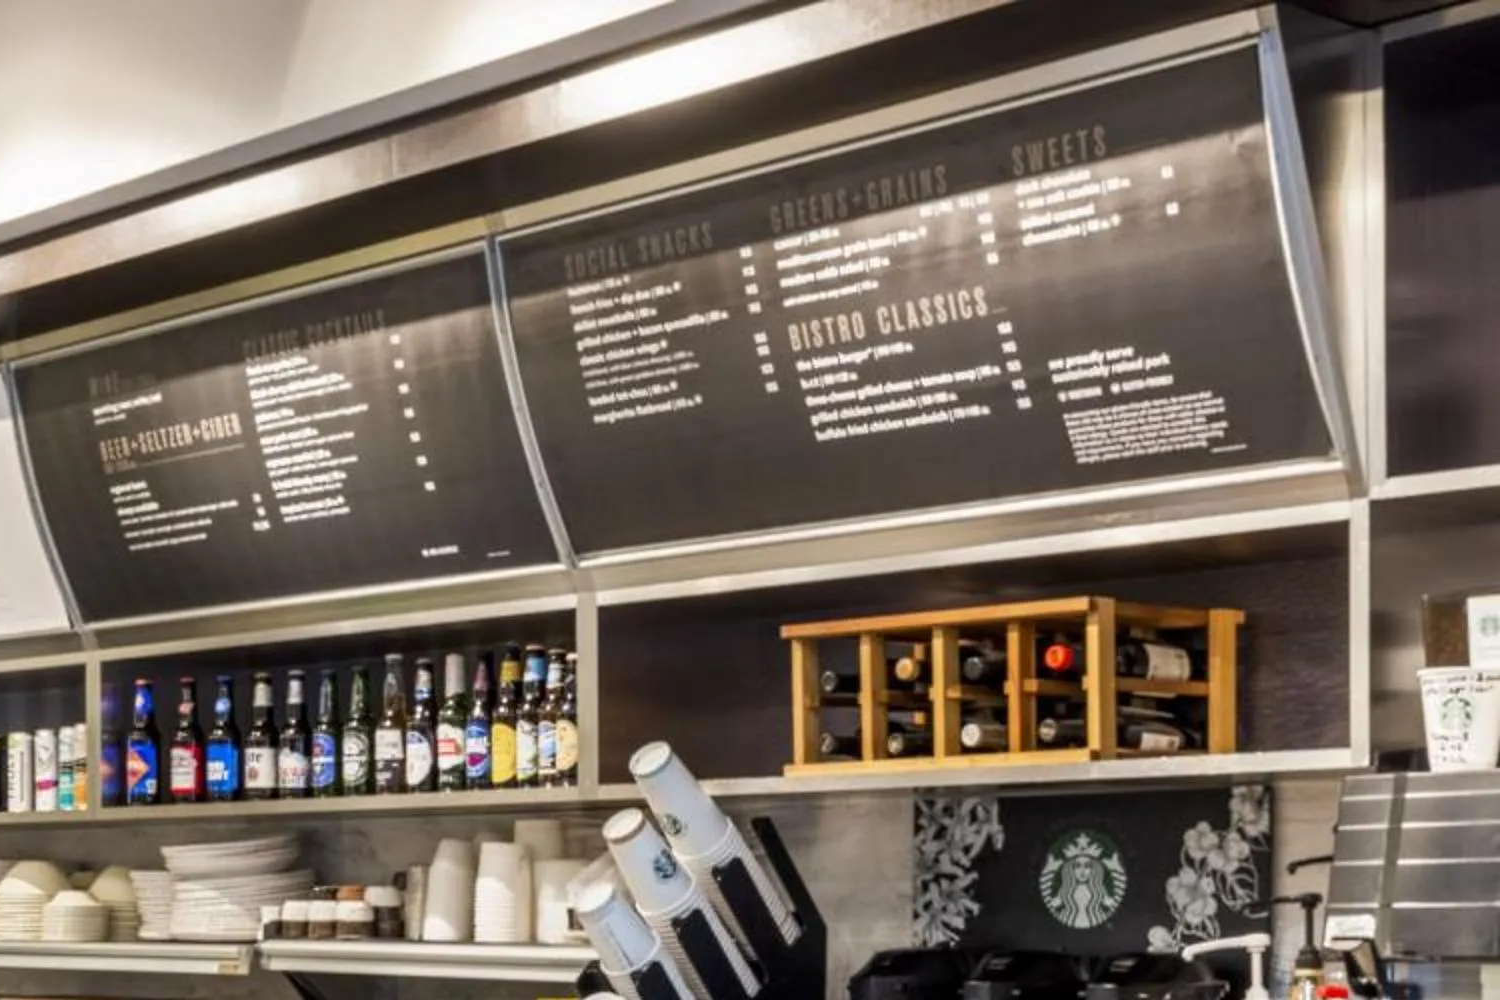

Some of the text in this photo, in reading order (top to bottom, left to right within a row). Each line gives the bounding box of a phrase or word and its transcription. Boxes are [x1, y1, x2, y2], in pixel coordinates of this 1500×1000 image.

[1011, 125, 1107, 176] SWEETS
[564, 221, 713, 280] SOCIAL SNACKS
[788, 310, 866, 352] BISTRO
[876, 285, 989, 336] CLASSICS
